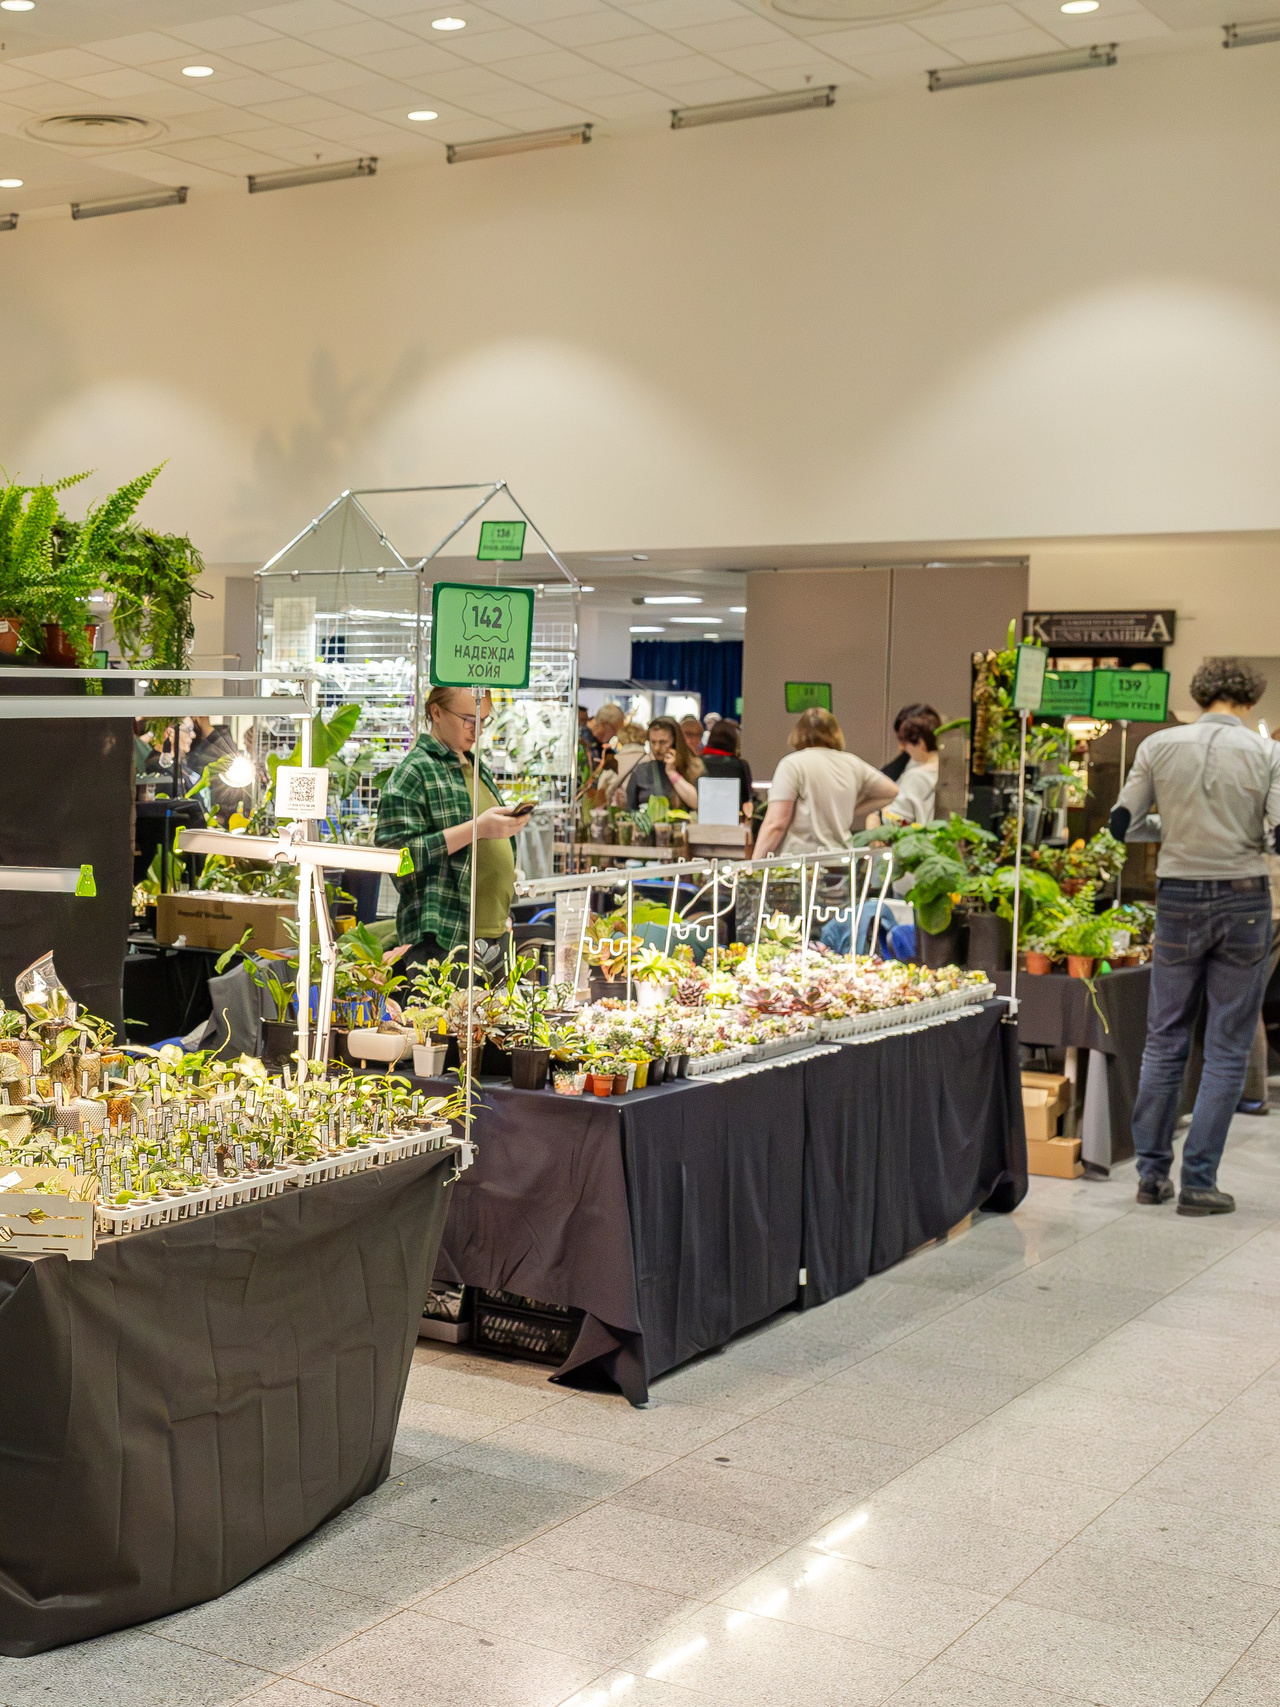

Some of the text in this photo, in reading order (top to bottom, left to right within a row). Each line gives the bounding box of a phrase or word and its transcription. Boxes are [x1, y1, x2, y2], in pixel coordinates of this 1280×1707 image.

[471, 605, 503, 629] 142
[454, 644, 515, 663] НАДЕЖДА
[467, 662, 501, 679] ХОЙЯ
[1118, 678, 1142, 691] 139
